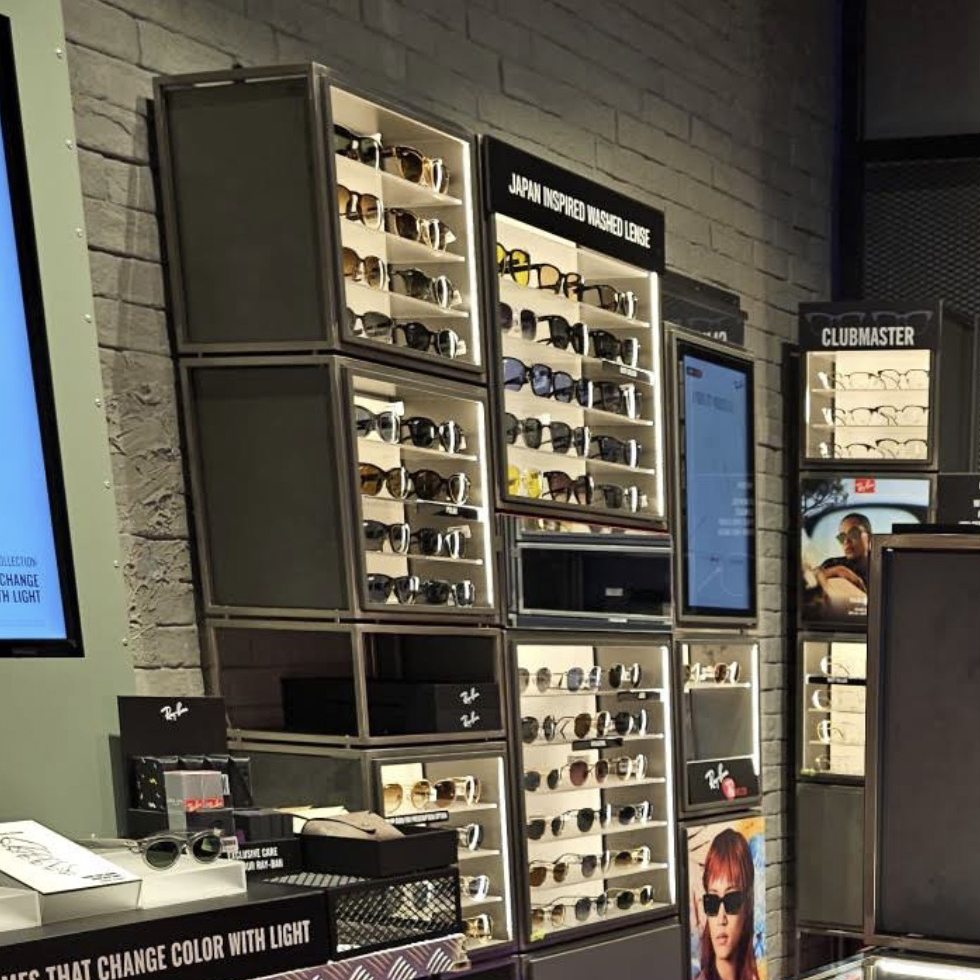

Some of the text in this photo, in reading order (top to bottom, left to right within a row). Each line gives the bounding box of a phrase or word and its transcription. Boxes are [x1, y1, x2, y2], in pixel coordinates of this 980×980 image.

[509, 172, 651, 249] JAPAN INSPIRED WASHED LENSE
[821, 326, 915, 347] CLUBMASTER
[0, 573, 40, 588] CHANGE
[12, 590, 41, 604] LIGHT
[171, 935, 225, 967] COLOR
[228, 926, 266, 956] WITH
[269, 919, 311, 947] LIGHT
